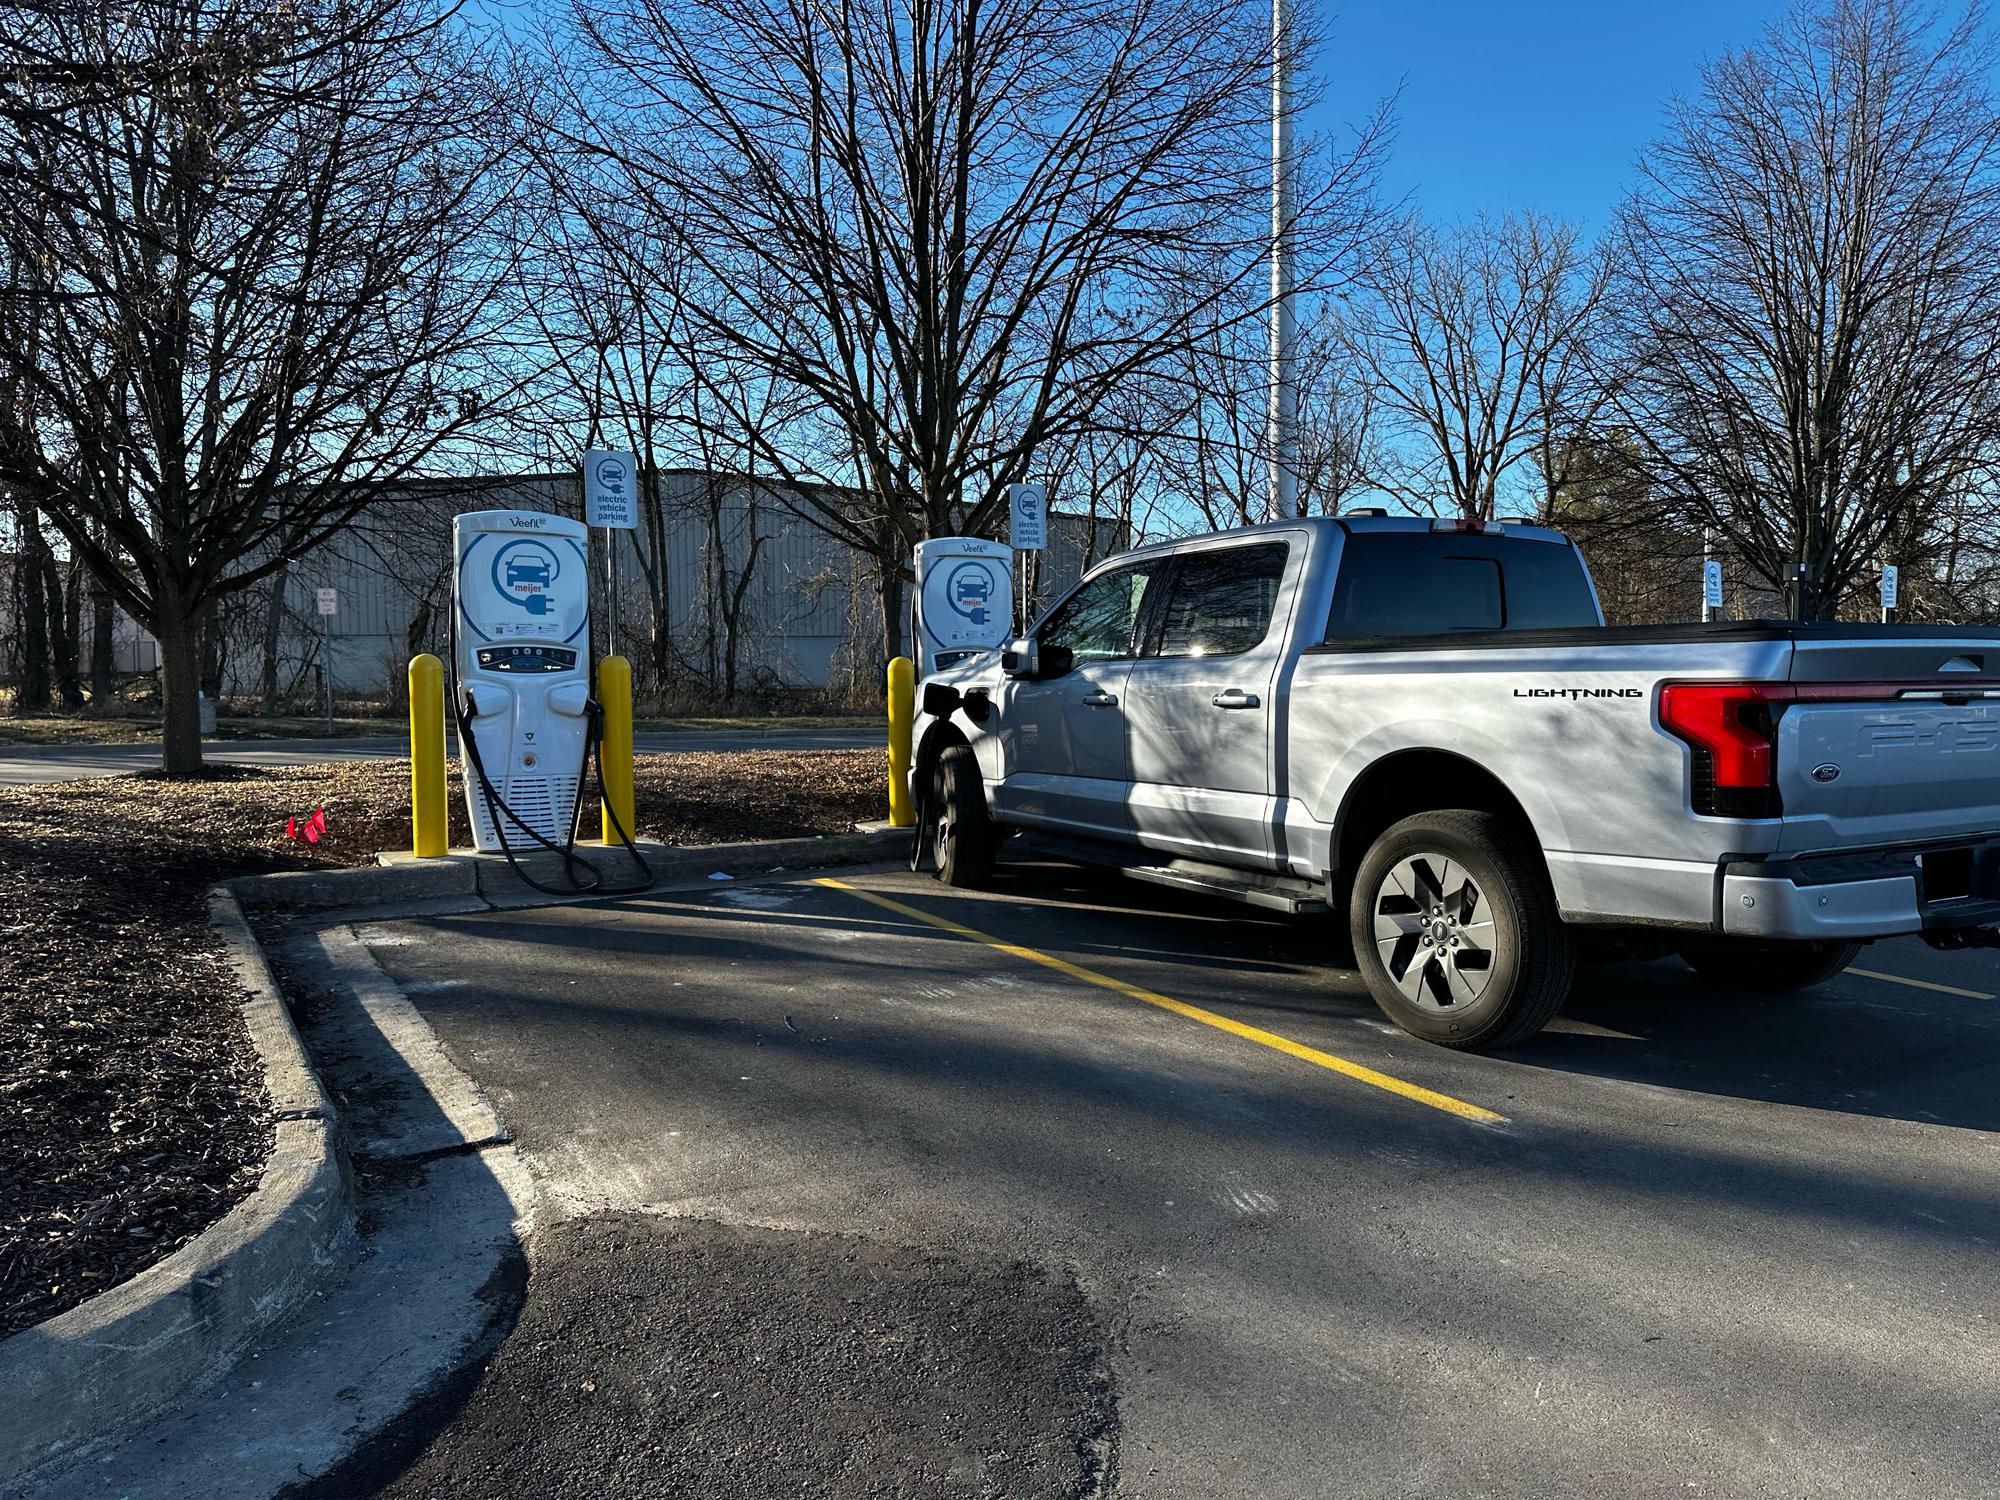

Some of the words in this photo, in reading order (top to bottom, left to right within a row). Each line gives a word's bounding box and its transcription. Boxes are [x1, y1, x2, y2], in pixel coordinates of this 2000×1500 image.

[597, 495, 627, 503] electric
[599, 504, 626, 512] vehicle
[598, 513, 628, 522] parking
[509, 516, 540, 528] Veefil
[1018, 536, 1040, 544] parking
[514, 583, 542, 593] meijer
[962, 599, 982, 607] meijer
[1513, 689, 1643, 701] LIGHTNING
